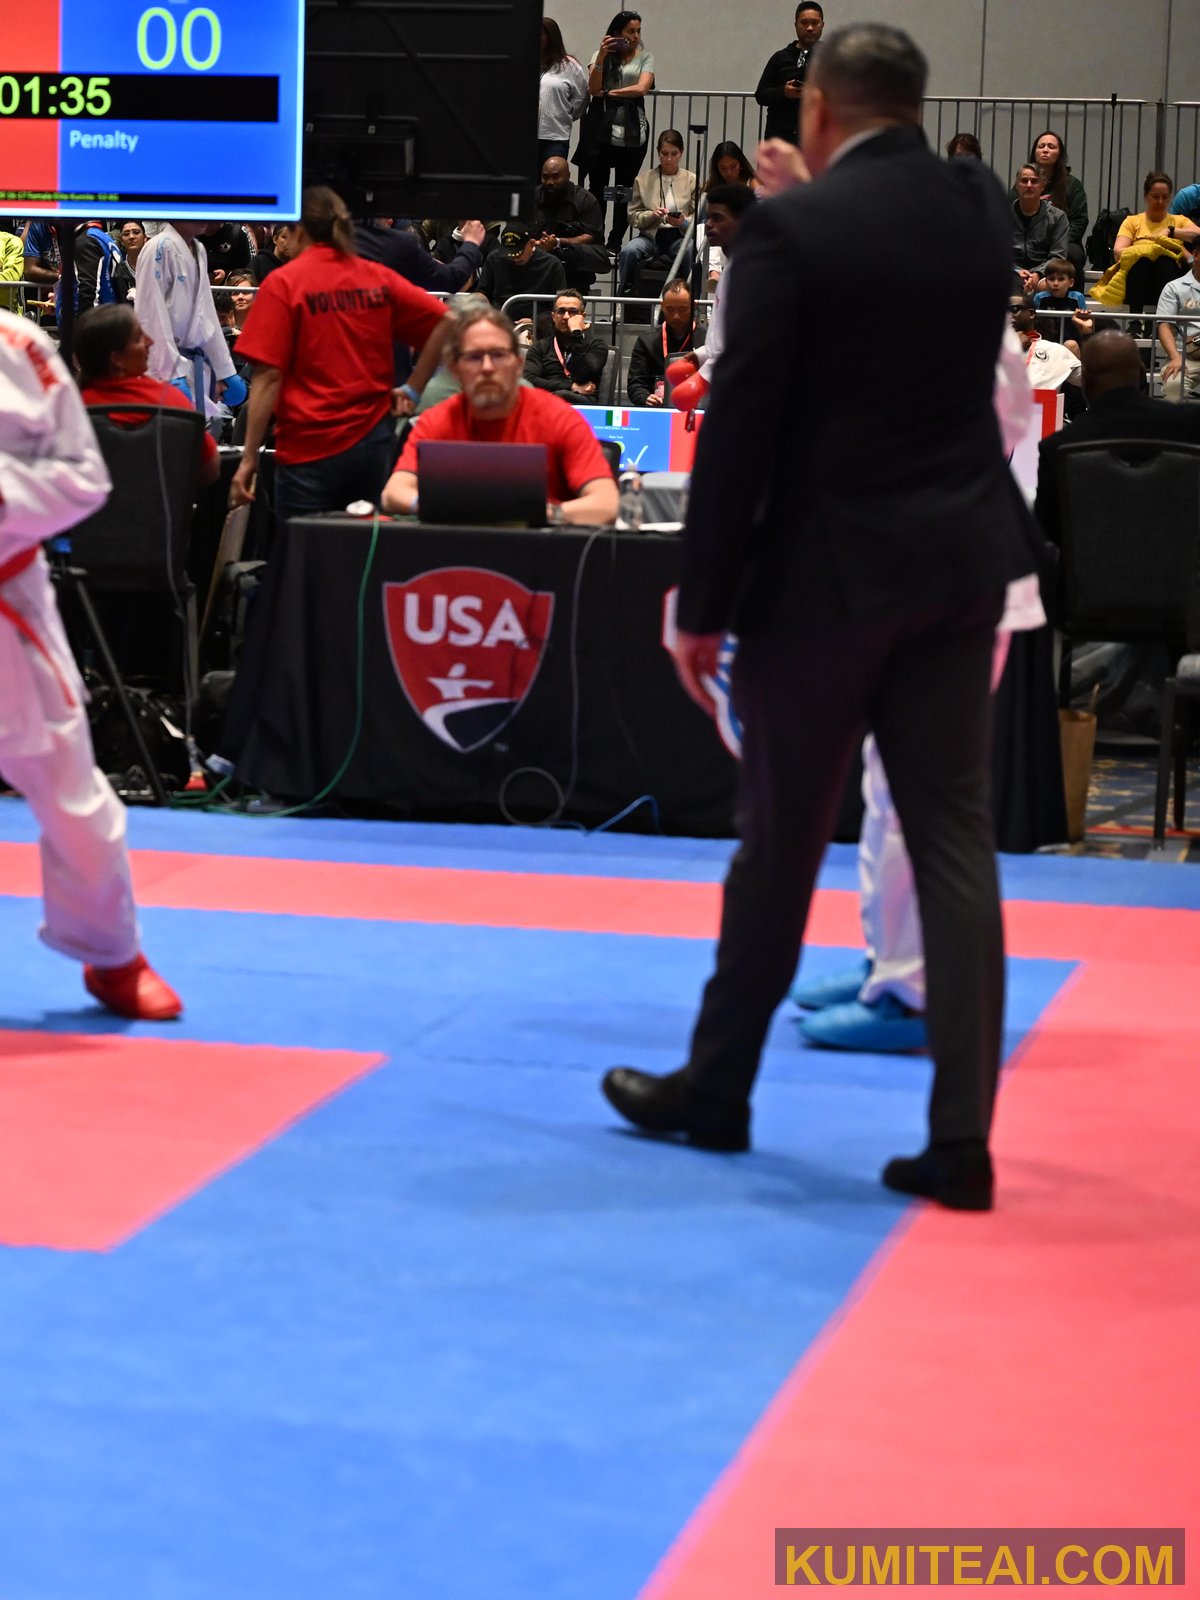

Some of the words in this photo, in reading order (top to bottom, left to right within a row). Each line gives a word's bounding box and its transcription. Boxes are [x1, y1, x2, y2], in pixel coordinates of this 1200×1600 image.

[136, 7, 222, 71] 00
[69, 130, 139, 152] Penalty
[404, 592, 531, 650] USA
